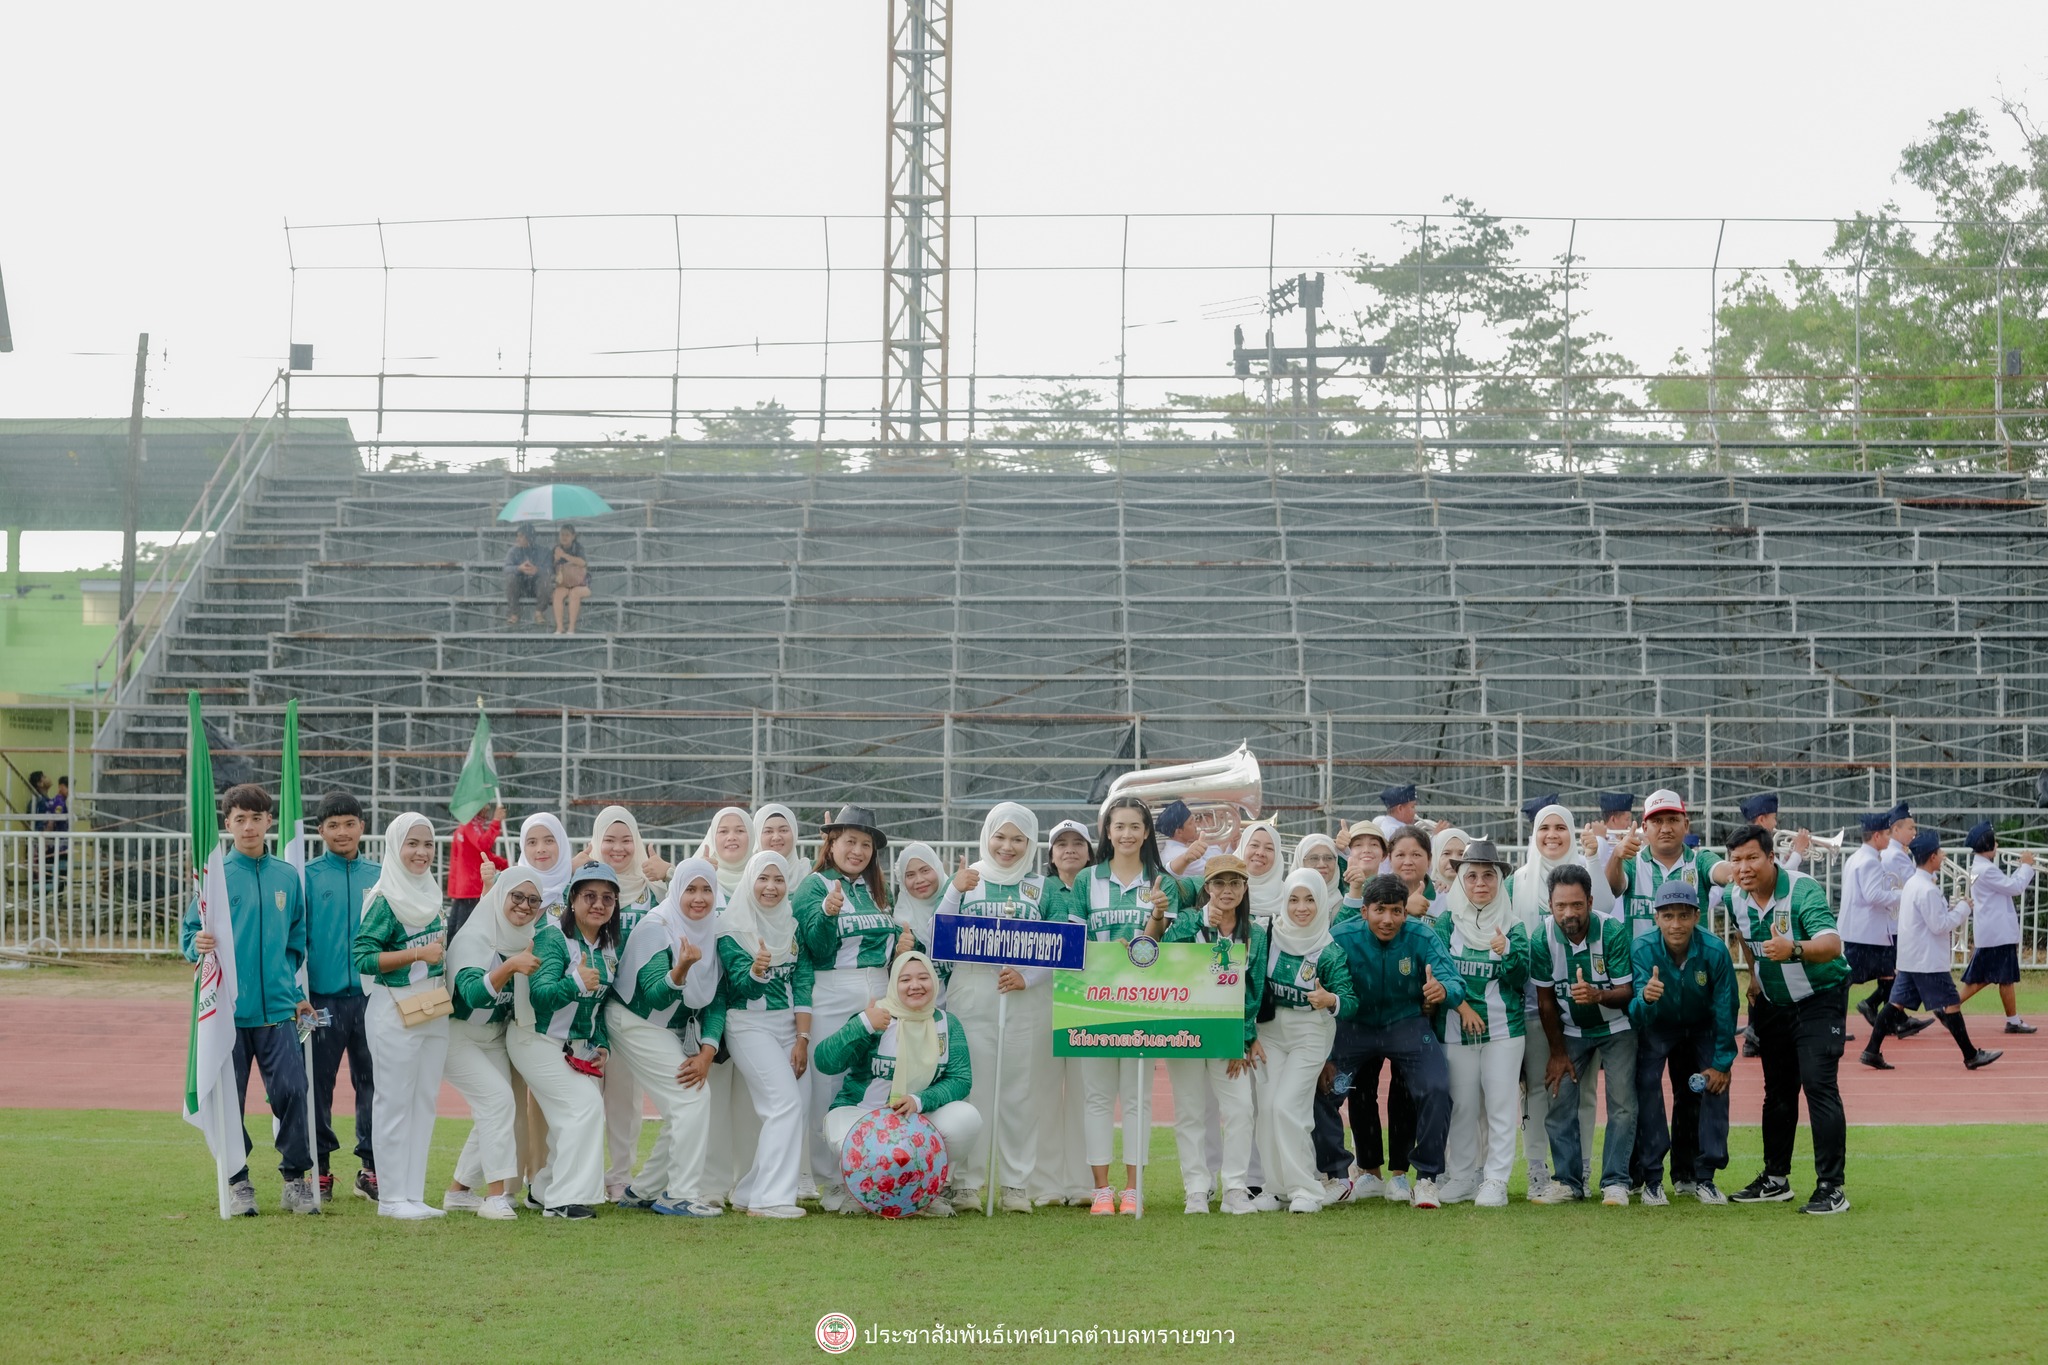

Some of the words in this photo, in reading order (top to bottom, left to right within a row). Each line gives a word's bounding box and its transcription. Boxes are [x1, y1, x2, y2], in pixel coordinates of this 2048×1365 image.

[955, 918, 1063, 962] เทศบาลตำบลทรายขาว
[1216, 973, 1239, 986] 20
[1086, 985, 1190, 1002] ทต.ทรายขาว
[1067, 1028, 1202, 1048] ไก่มรกตอันดามัน
